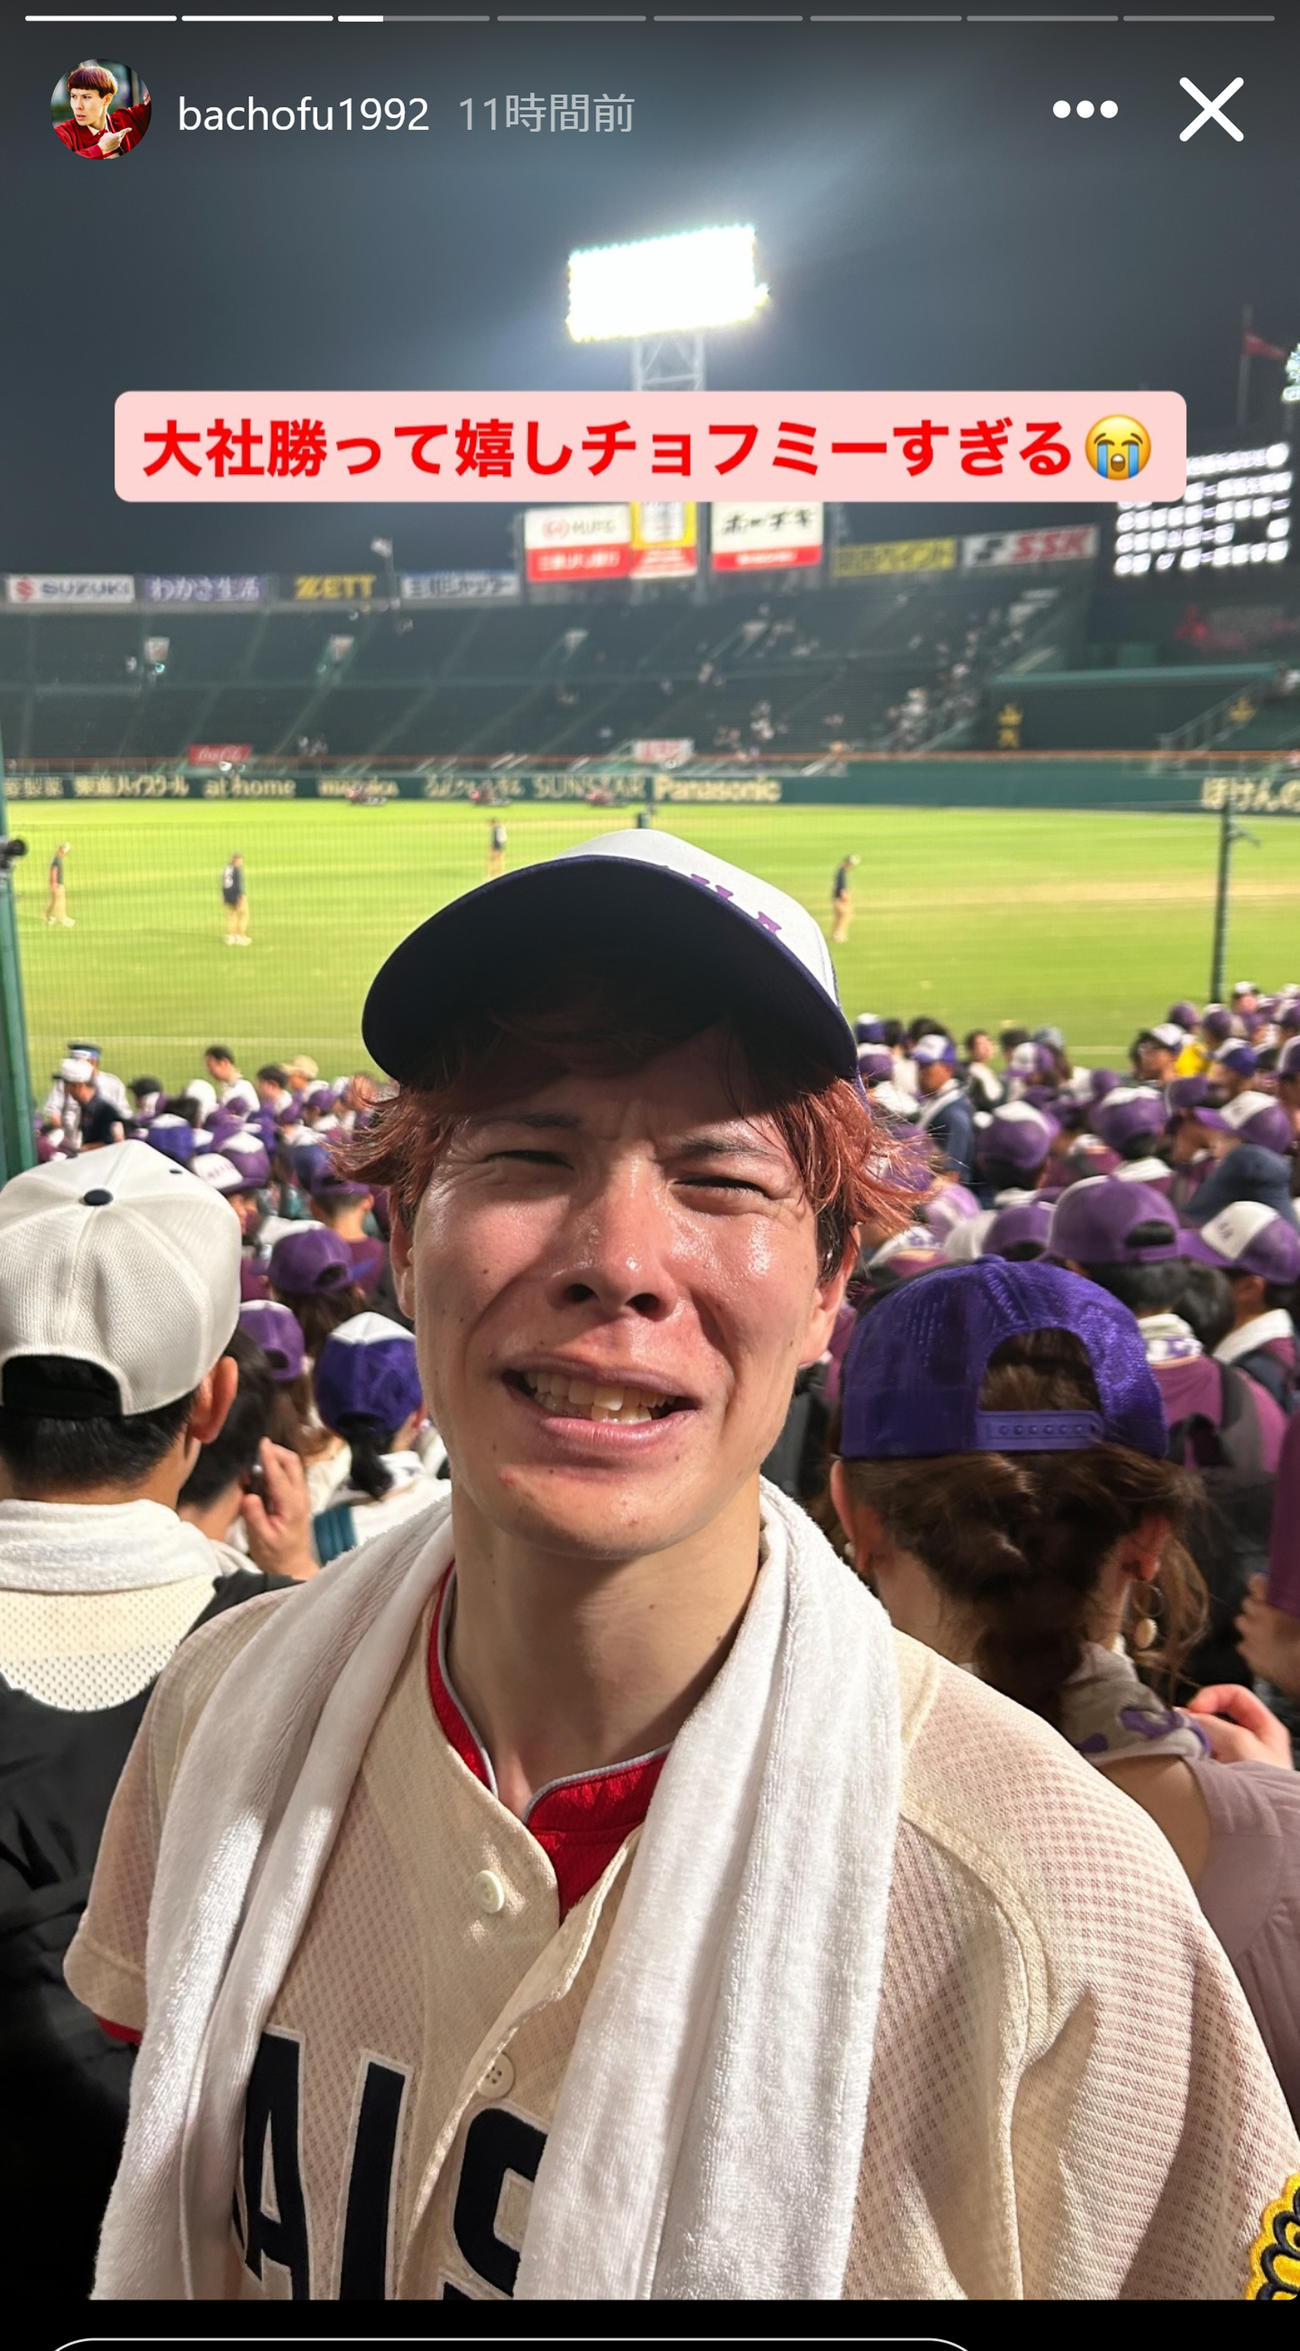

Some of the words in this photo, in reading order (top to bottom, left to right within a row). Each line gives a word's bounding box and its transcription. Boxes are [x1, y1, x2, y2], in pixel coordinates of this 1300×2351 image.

[1012, 528, 1093, 562] SSK
[40, 580, 131, 597] SUZUKI
[150, 575, 261, 600] わかさ生活
[294, 573, 377, 599] ZETT
[231, 775, 297, 798] home
[653, 774, 783, 801] Panasonic
